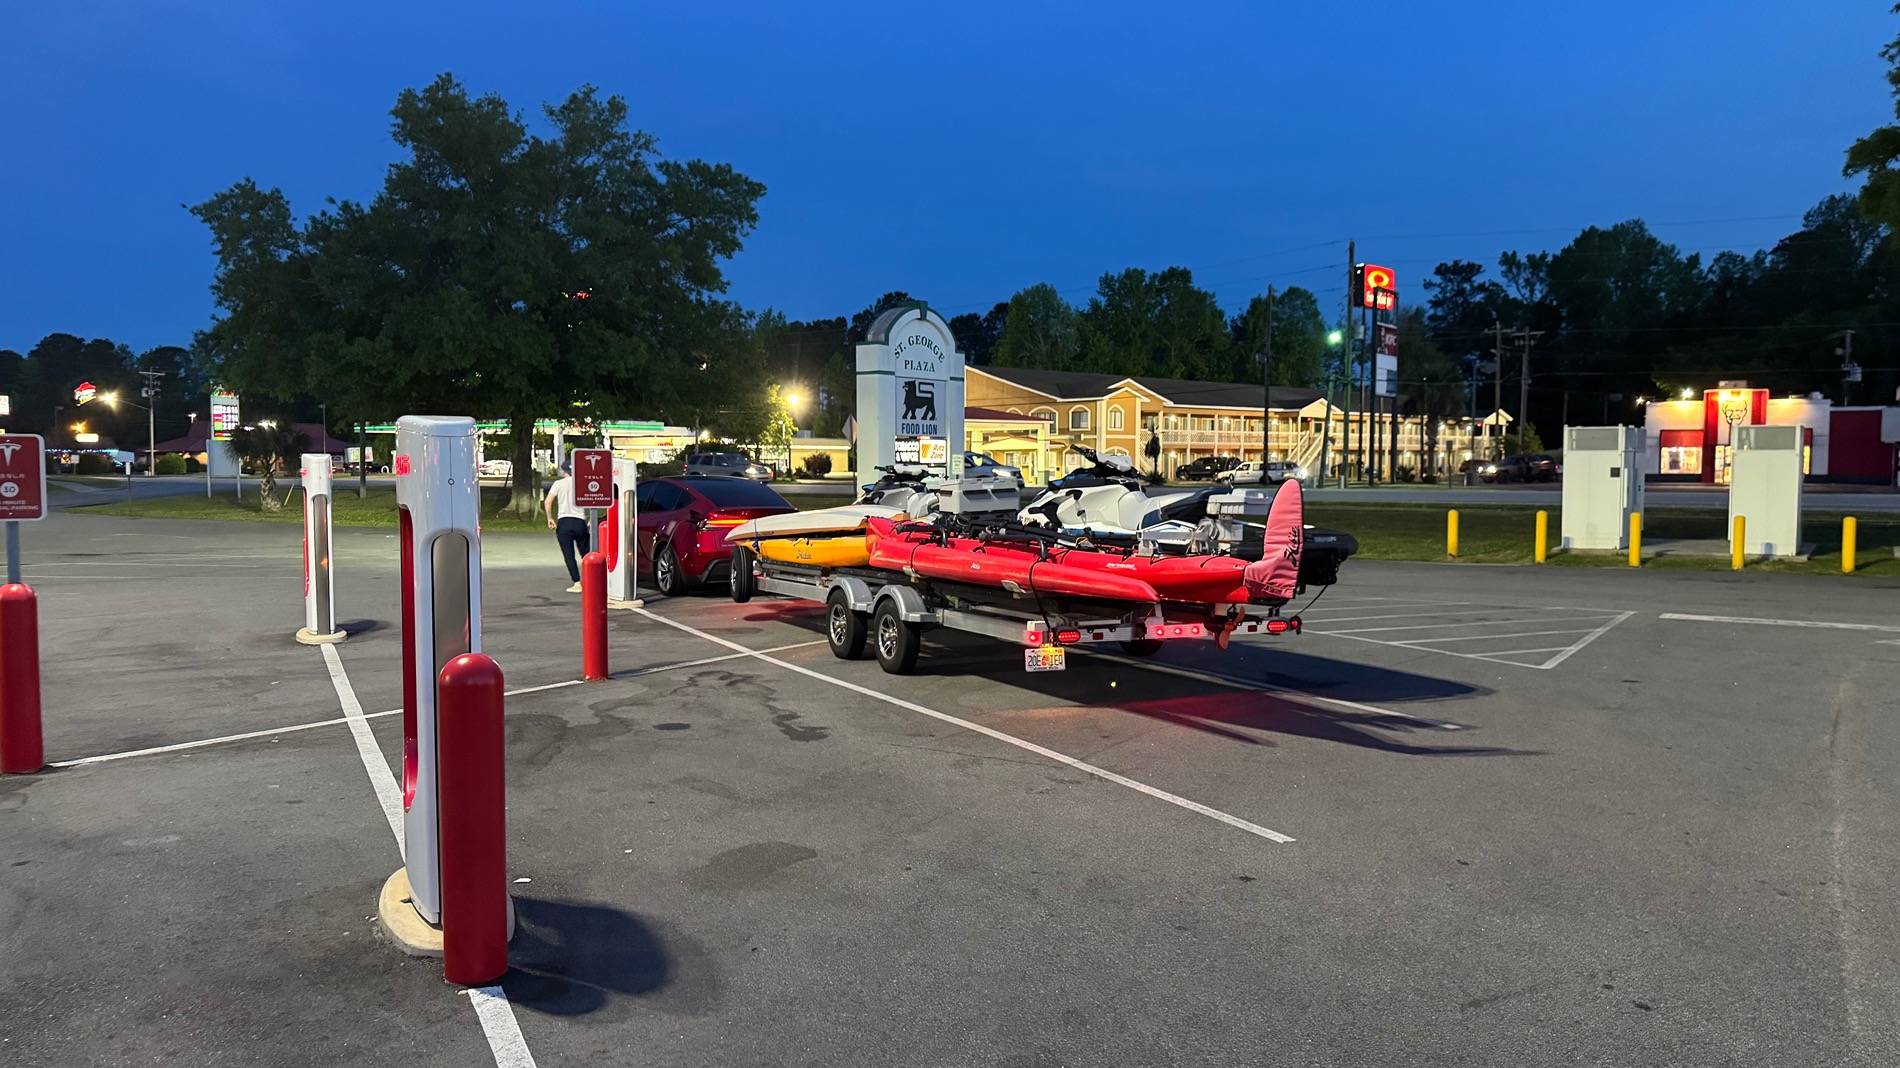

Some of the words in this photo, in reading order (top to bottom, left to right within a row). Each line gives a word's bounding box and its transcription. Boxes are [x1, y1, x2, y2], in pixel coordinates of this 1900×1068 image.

[894, 343, 906, 359] ST.
[908, 334, 945, 363] GEORGE
[904, 359, 935, 372] PLAZA
[901, 423, 920, 435] FOOD
[922, 423, 938, 435] LION
